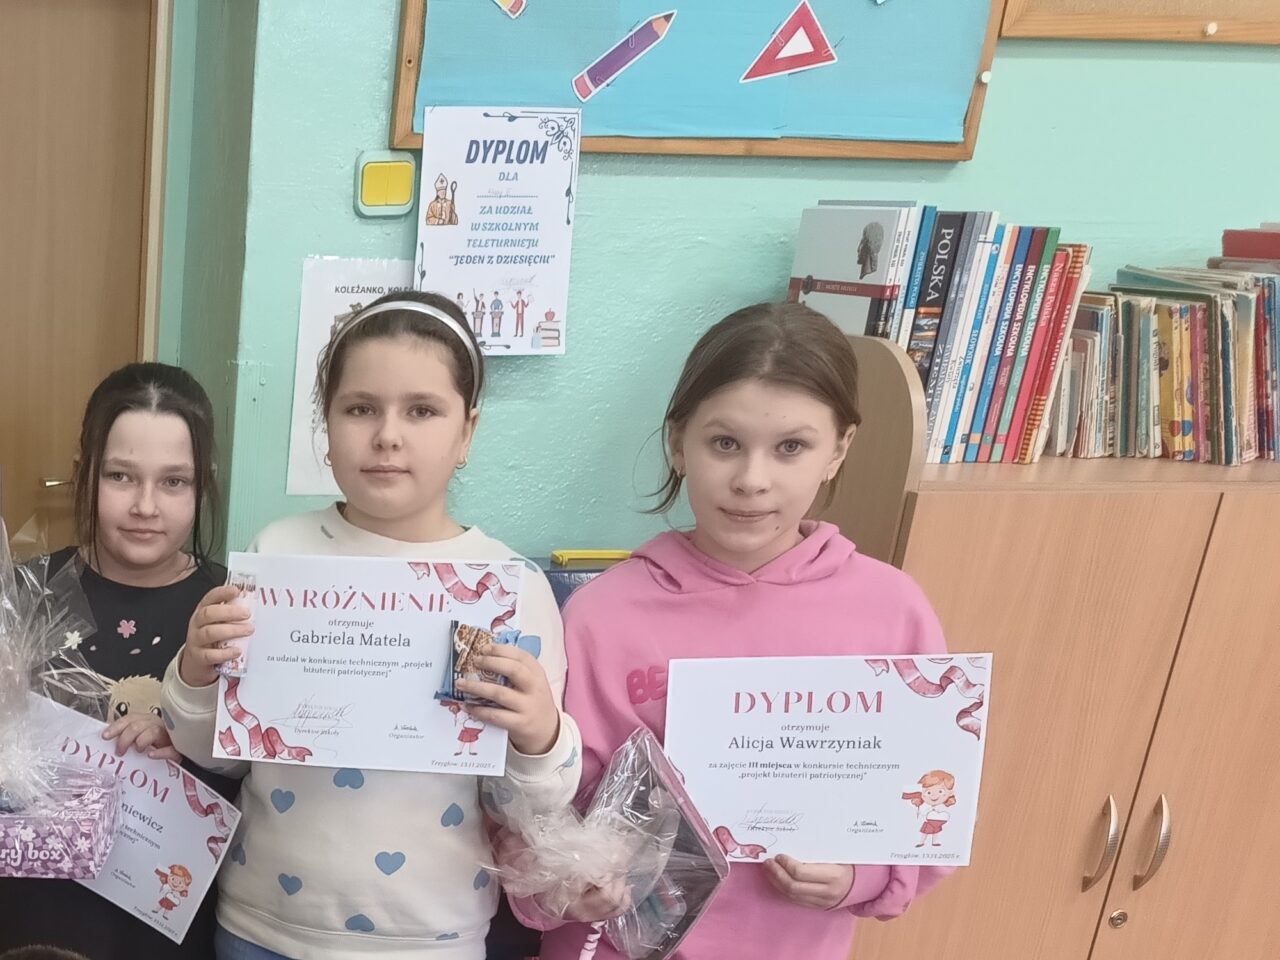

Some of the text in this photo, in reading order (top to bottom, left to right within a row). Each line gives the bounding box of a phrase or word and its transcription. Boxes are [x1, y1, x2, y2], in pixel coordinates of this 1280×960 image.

[465, 140, 549, 165] DYPLOM
[498, 172, 519, 181] DLA
[479, 205, 533, 215] ZA UDZIAŁ
[470, 222, 539, 232] W SZKOLNYM
[466, 238, 538, 248] TELETURNIEJU
[487, 256, 493, 264] Z
[927, 228, 954, 301] POLSKA
[335, 285, 386, 296] KOLEŻANKO,
[1040, 263, 1064, 326] Nasza Polska
[994, 264, 1023, 356] ENCYKLOPEDIA SZKOLNA
[1006, 265, 1036, 357] ENCYKLOPEDIA SZKOLNA
[1020, 265, 1050, 356] ENCYKLOPEDIA SZKOLNA
[259, 585, 452, 613] WYRÓŻNIENIE
[328, 618, 374, 629] otrzymuje
[290, 630, 411, 648] Gabriela Matela
[277, 655, 299, 663] udział
[309, 656, 347, 666] konkursie
[348, 659, 399, 668] technicznym
[303, 665, 336, 676] biżuterii
[734, 690, 883, 714] DYPLOM
[781, 723, 830, 732] otrzymuje
[728, 736, 882, 752] Alicja Wawrzyniak
[61, 736, 171, 803] DYPLOM
[719, 762, 747, 770] zajęcie
[760, 761, 792, 770] miejsca
[846, 762, 900, 771] technicznym
[773, 771, 808, 779] biżuterii
[121, 802, 164, 834] niewicz
[28, 841, 62, 861] box
